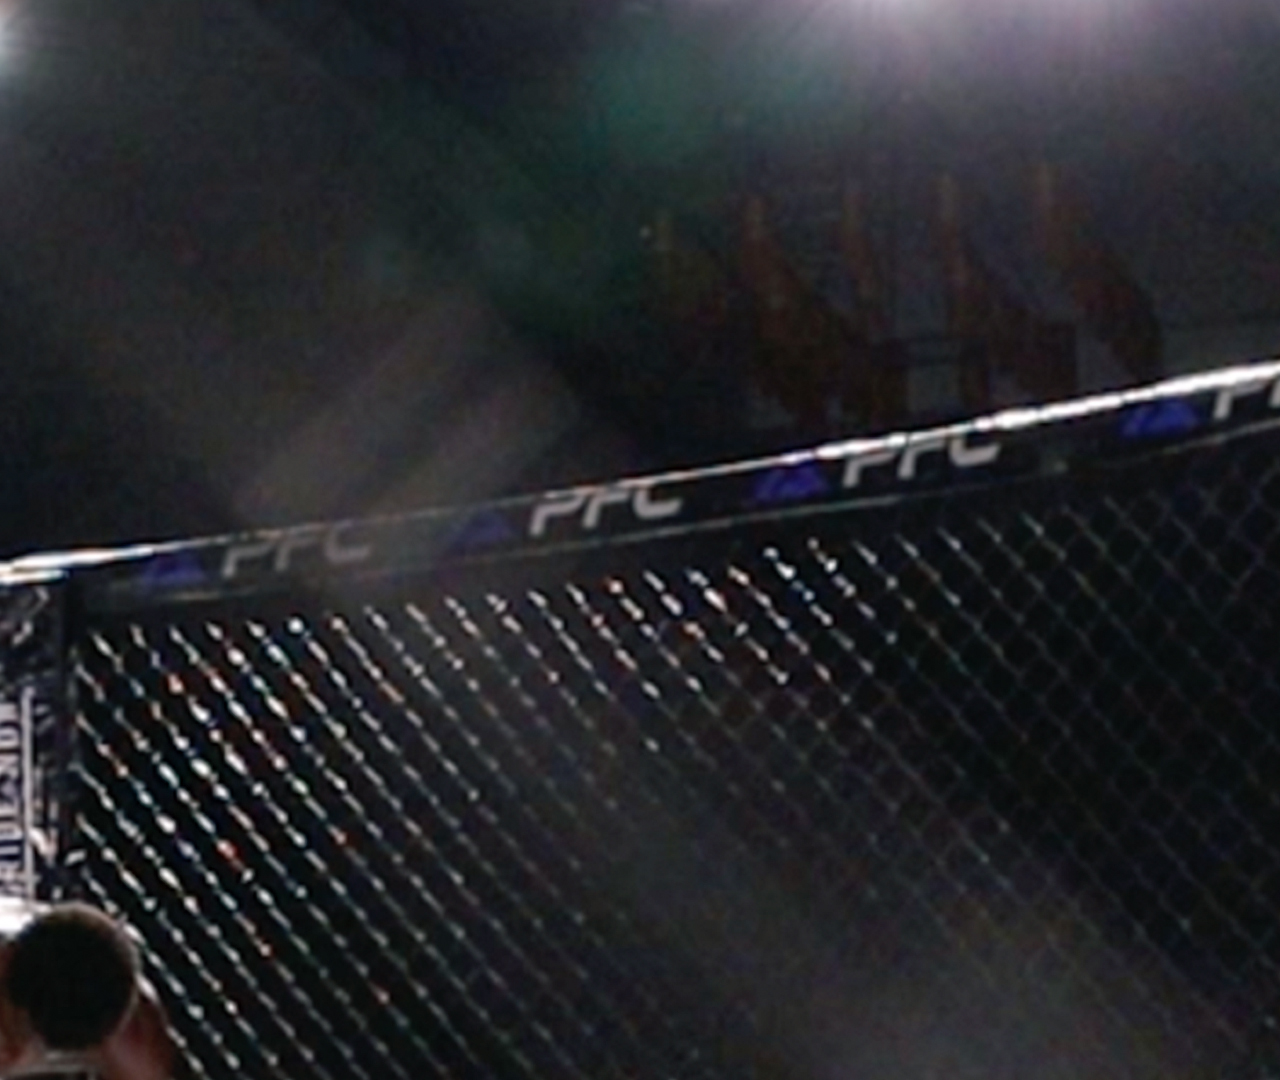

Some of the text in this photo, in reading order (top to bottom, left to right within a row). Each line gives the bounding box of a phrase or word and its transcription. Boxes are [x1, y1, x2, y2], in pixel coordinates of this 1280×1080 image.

[842, 432, 1001, 488] PFC
[529, 480, 683, 536] PFC
[219, 521, 372, 576] PFC
